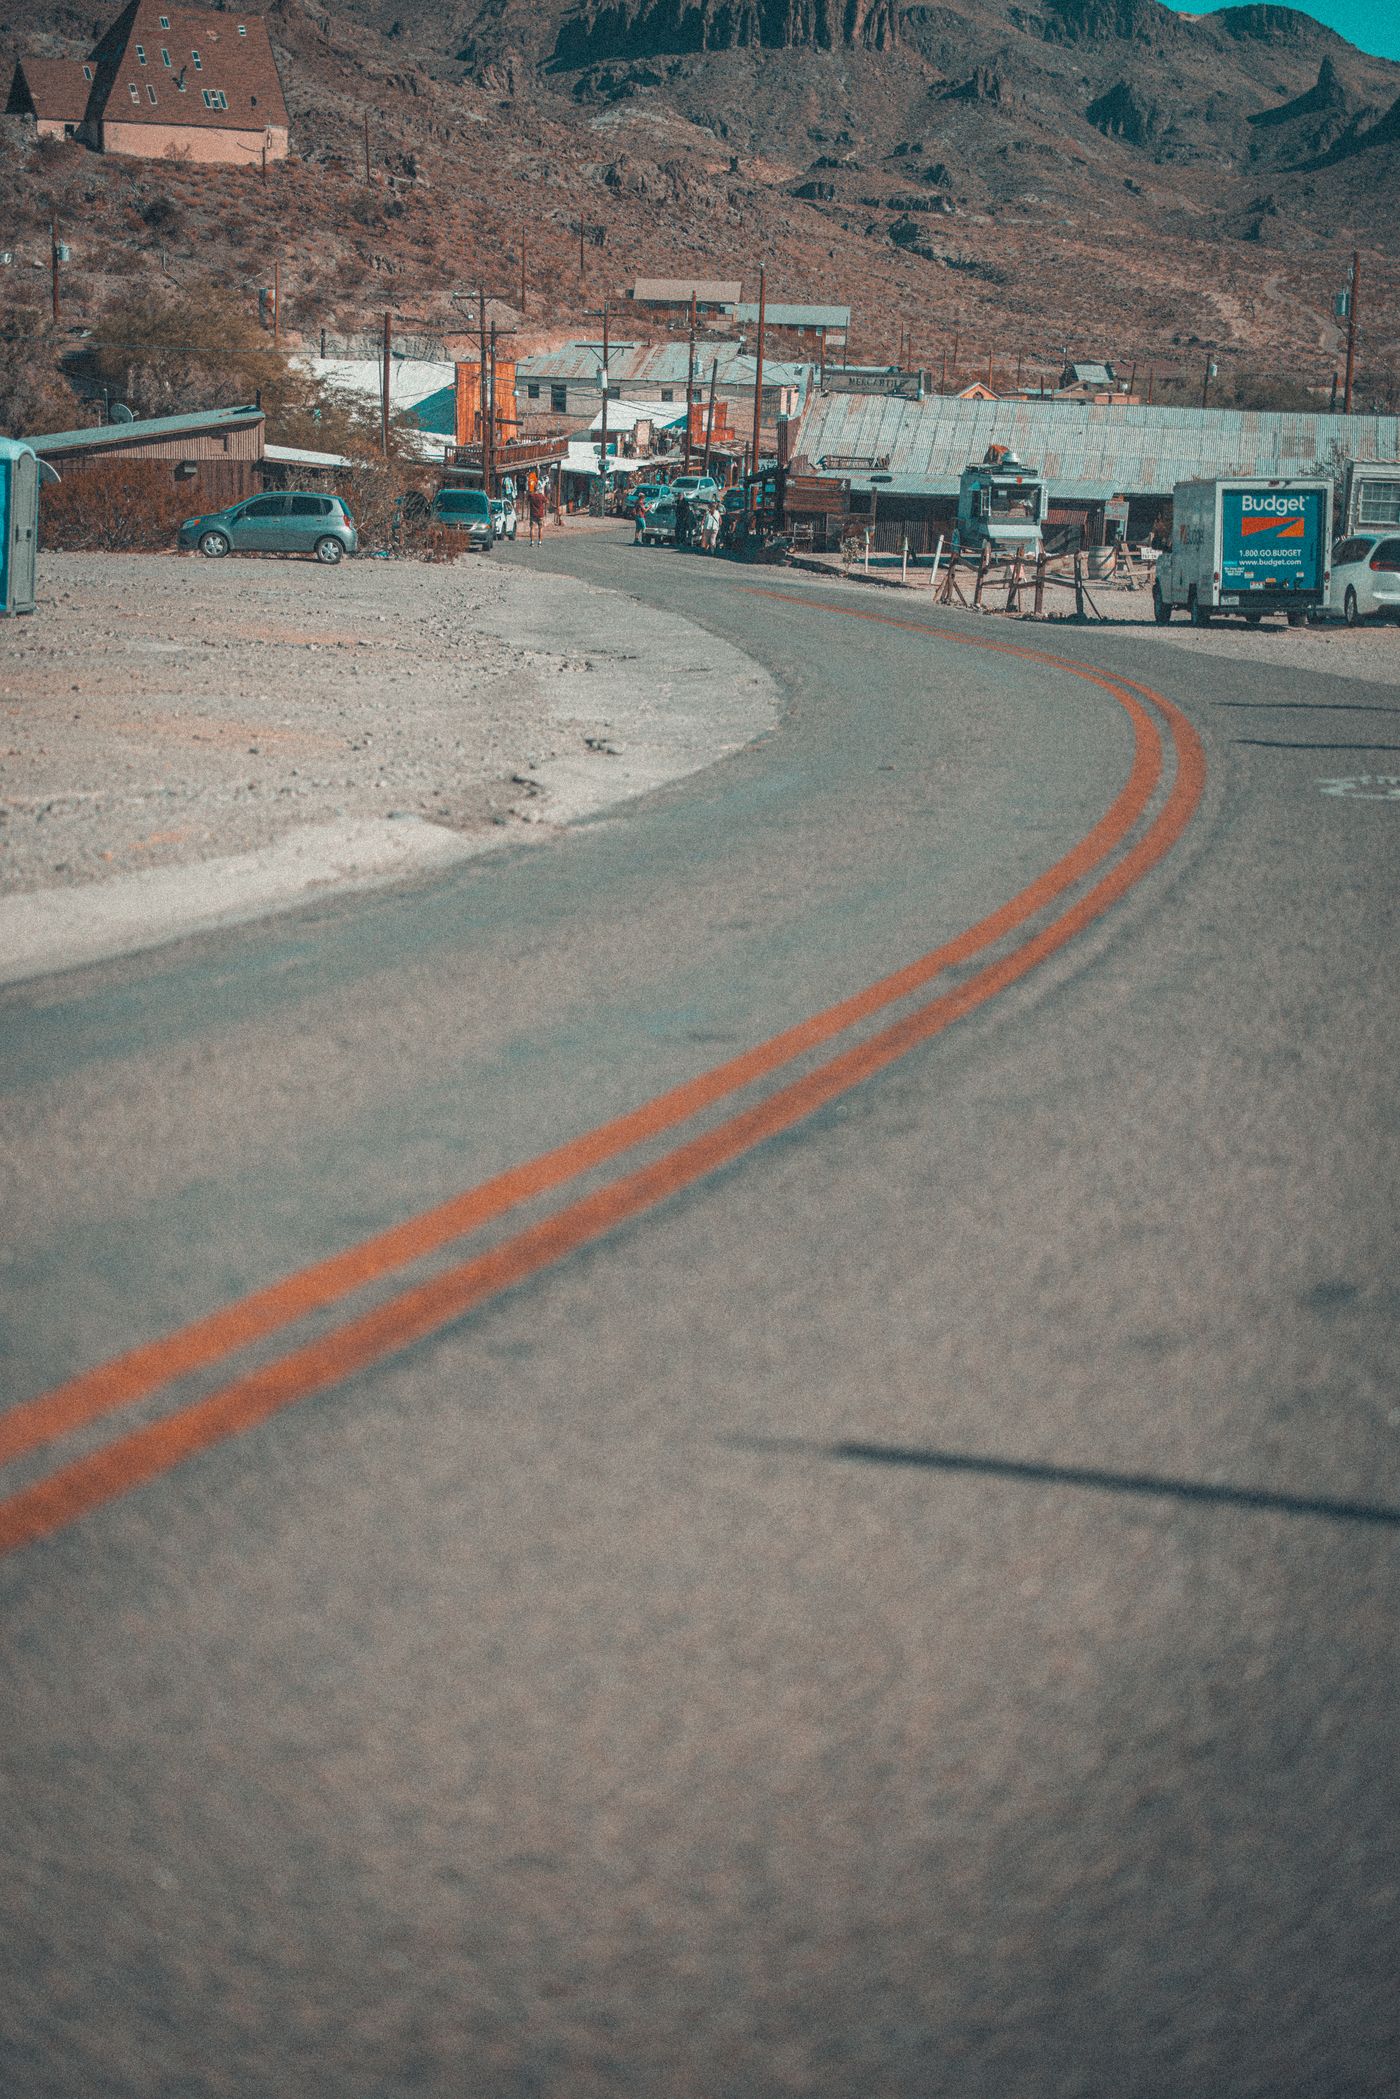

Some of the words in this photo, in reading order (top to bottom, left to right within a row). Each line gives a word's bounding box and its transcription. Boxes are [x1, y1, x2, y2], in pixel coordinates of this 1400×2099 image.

[1242, 495, 1305, 516] Budget
[1239, 549, 1302, 557] 1.800.GO.BUDGET
[1239, 559, 1302, 567] www.budget.com
